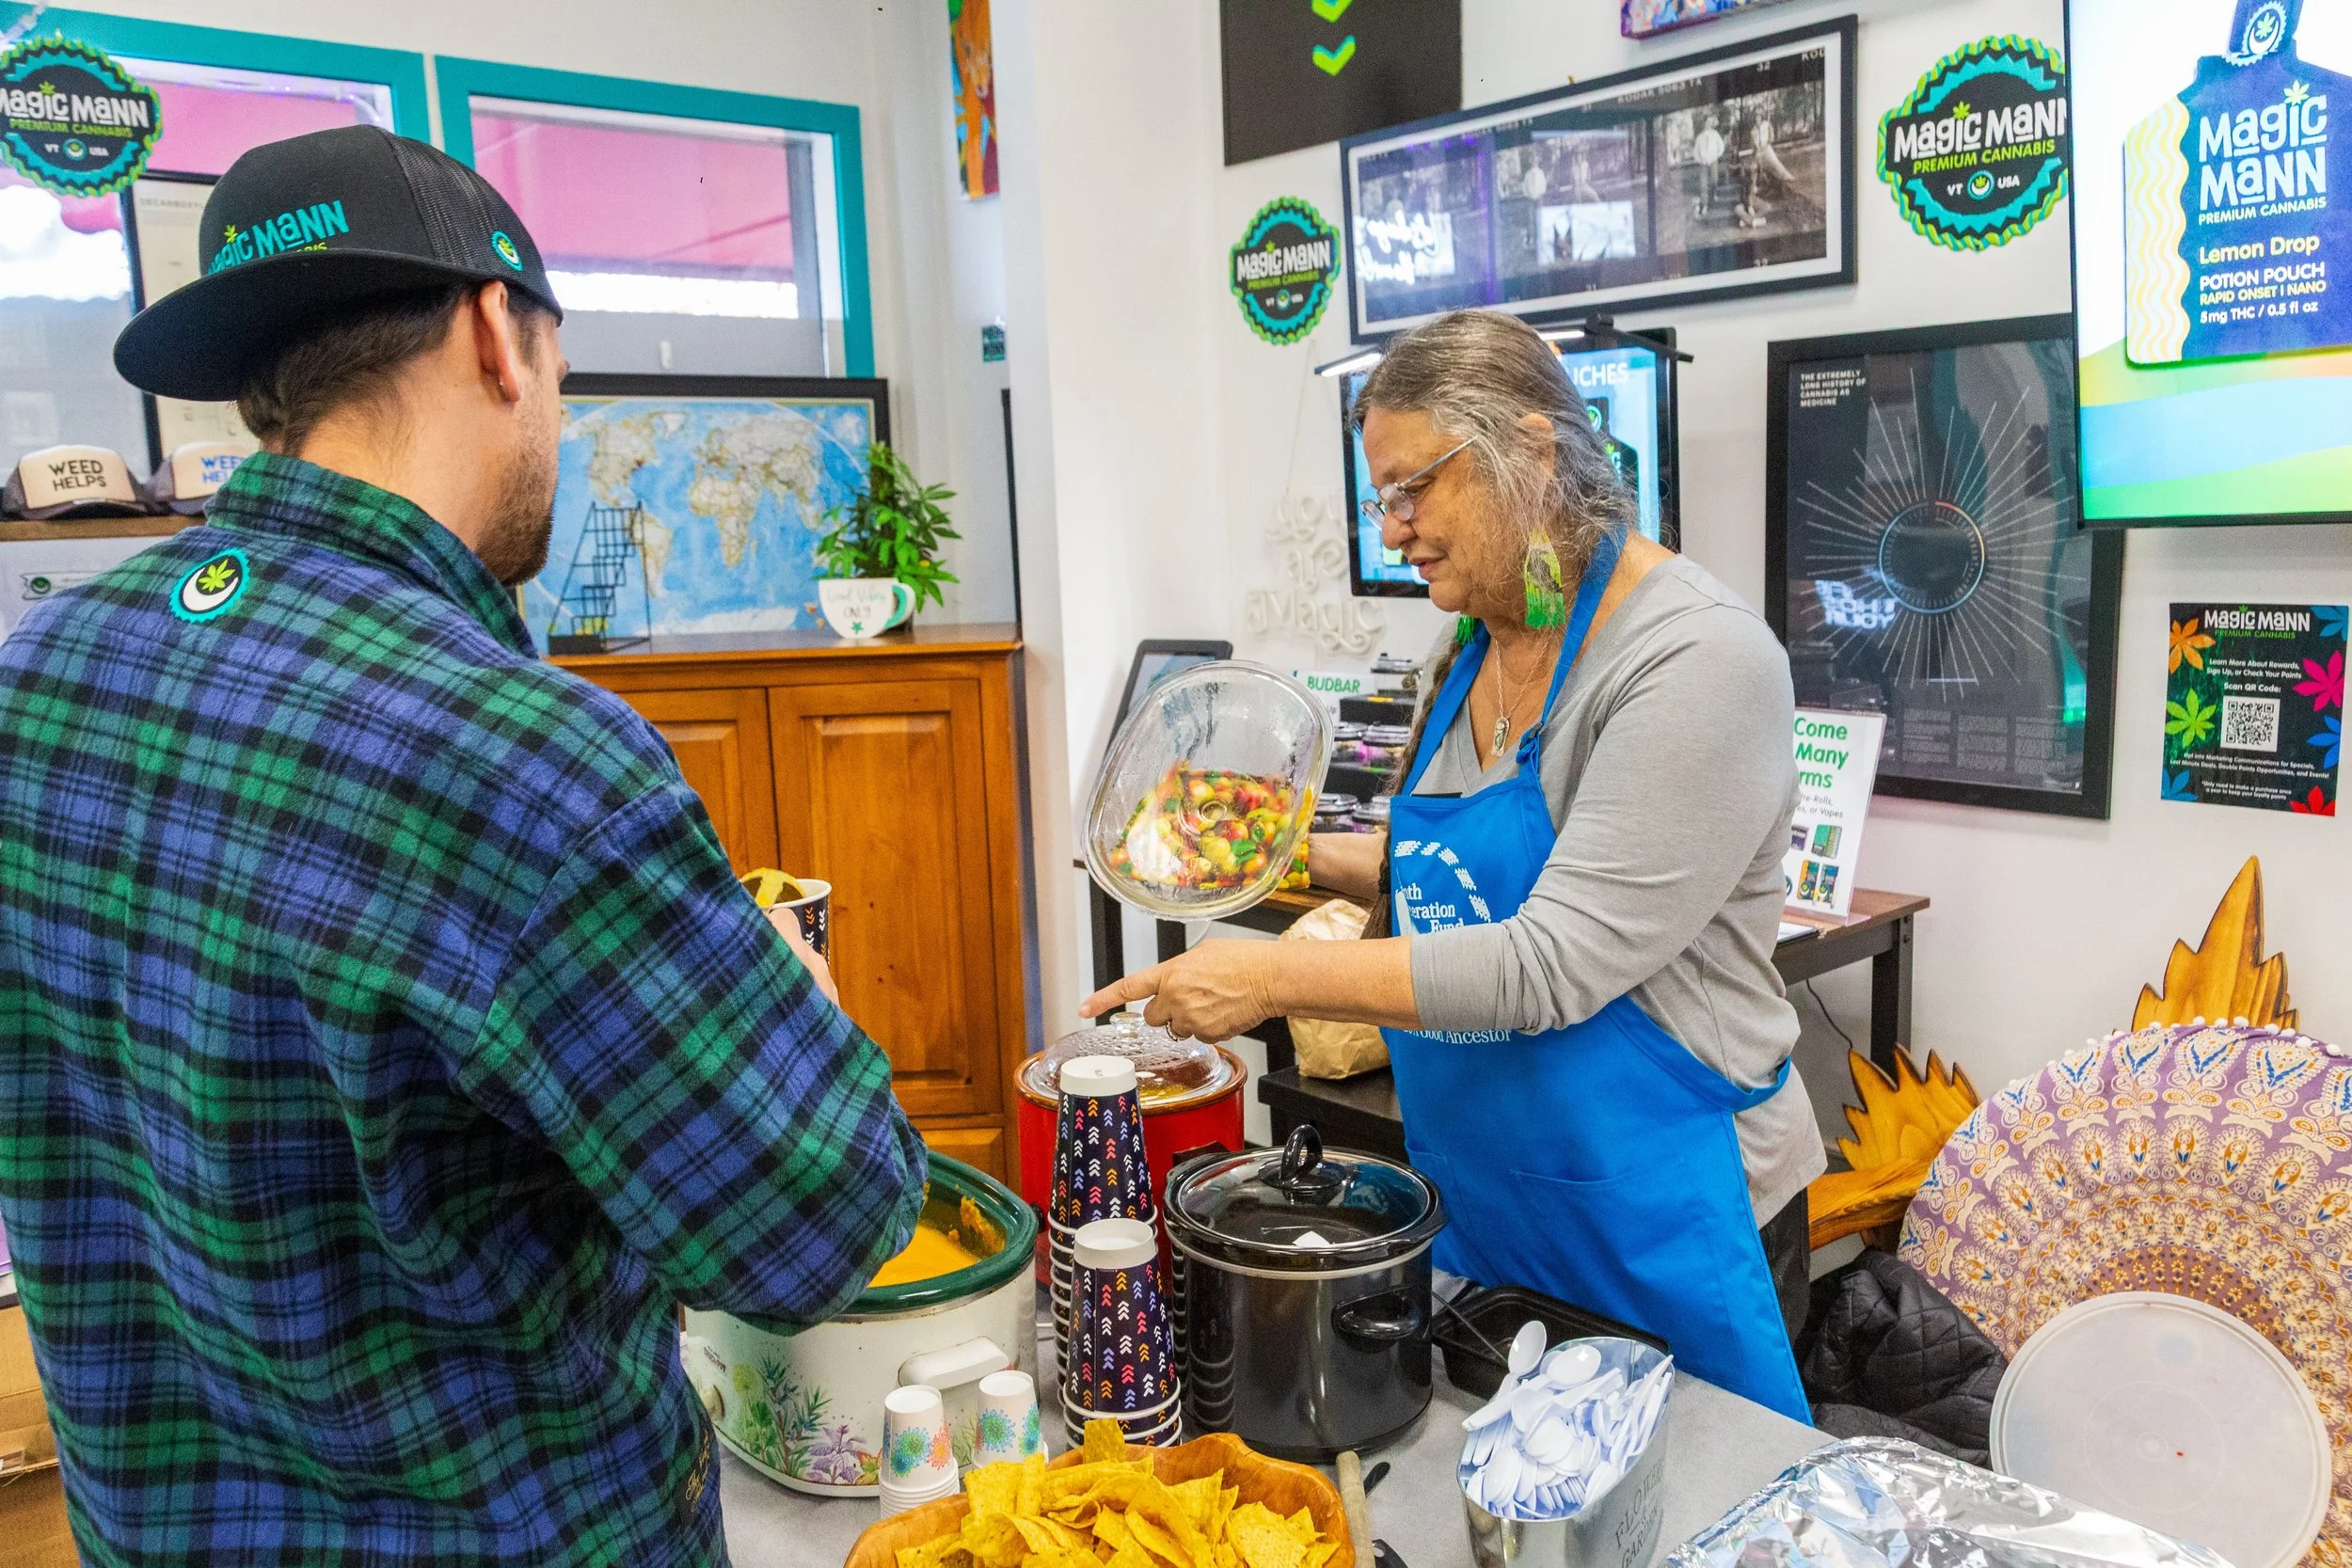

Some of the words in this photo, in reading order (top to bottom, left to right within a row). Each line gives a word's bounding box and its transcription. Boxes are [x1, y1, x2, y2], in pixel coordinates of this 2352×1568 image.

[9, 118, 69, 133] PREMIUM
[1914, 152, 1977, 174] PREMIUM
[1981, 138, 2056, 165] CANNABIS
[1947, 183, 1963, 196] VT
[1998, 175, 2020, 189] USA
[2199, 206, 2256, 226] PREMIUM
[2260, 196, 2328, 216] CANNABIS
[2200, 242, 2265, 265] Lemon
[2270, 235, 2320, 256] Drop
[2200, 269, 2259, 292] POTION
[2264, 261, 2326, 284] POUCH
[2200, 290, 2234, 306] RAPID
[2238, 285, 2278, 301] ONSET
[2287, 280, 2327, 296] NANO
[2200, 309, 2228, 324] 5mg
[2230, 306, 2255, 321] THC
[2267, 303, 2286, 316] 0.5
[2302, 301, 2318, 312] oz
[1801, 372, 1815, 381] THE
[1817, 370, 1861, 380] EXTREMELY
[1801, 381, 1820, 390] LONG
[1821, 378, 1854, 388] HISTORY
[1855, 377, 1867, 387] OF
[1800, 388, 1838, 399] CANNABIS
[1800, 397, 1836, 407] MEDICINE
[48, 459, 103, 477] WEED
[200, 455, 244, 469] WEE
[53, 474, 107, 491] HELPS
[2215, 629, 2252, 638] PREMIUM
[2254, 630, 2296, 640] CANNABIS
[2229, 658, 2246, 667] More
[2248, 659, 2267, 668] About
[2269, 660, 2300, 670] Rewards,
[2206, 667, 2220, 675] Sign
[2243, 668, 2264, 677] Check
[2265, 670, 2280, 678] Your
[2280, 671, 2302, 679] Points
[1307, 675, 1361, 693] BUDBAR
[2223, 682, 2243, 690] Scan
[2245, 683, 2256, 691] QR
[2258, 684, 2281, 693] Code:
[1793, 718, 1848, 740] Come
[1795, 742, 1850, 770] Many
[2233, 756, 2280, 767] Communications
[1820, 808, 1844, 818] Vapes
[1446, 1028, 1512, 1044] Ancestor
